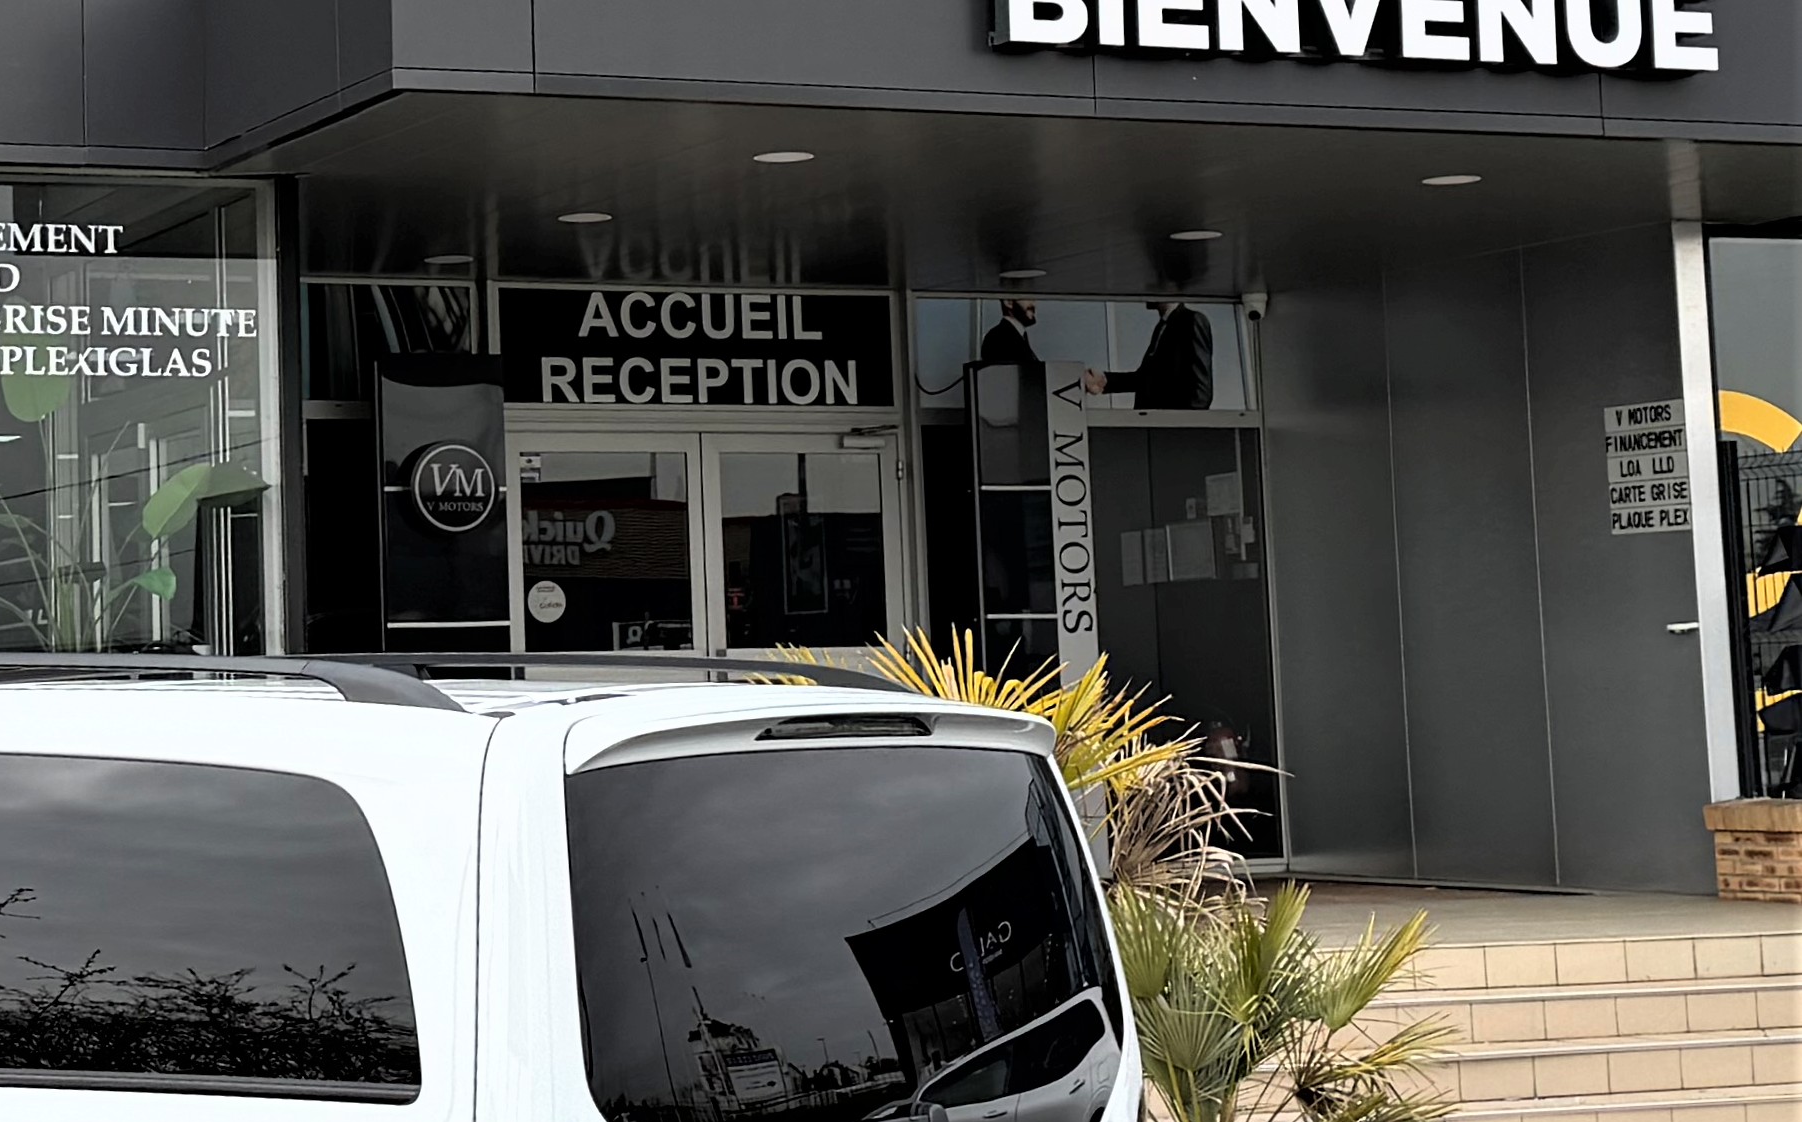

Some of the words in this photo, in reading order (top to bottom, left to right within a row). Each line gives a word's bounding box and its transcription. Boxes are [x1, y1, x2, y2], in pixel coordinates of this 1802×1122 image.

[100, 306, 258, 338] MINUTE
[577, 291, 823, 340] ACCUEIL
[0, 346, 212, 377] PLEXIGLAS
[540, 357, 858, 405] RECEPTION
[1052, 379, 1083, 411] V
[1615, 409, 1623, 427] V
[1628, 404, 1672, 426] MOTORS
[1605, 428, 1683, 453] FINANCEMENT
[429, 463, 486, 498] VM
[1619, 459, 1642, 478] LOA
[1652, 456, 1675, 474] LLD
[426, 502, 436, 512] V
[438, 501, 484, 512] MOTORS
[1610, 485, 1646, 505] CARTE
[1651, 481, 1688, 501] GRISE
[1053, 430, 1094, 634] MOTORS
[1659, 508, 1690, 527] PLEX
